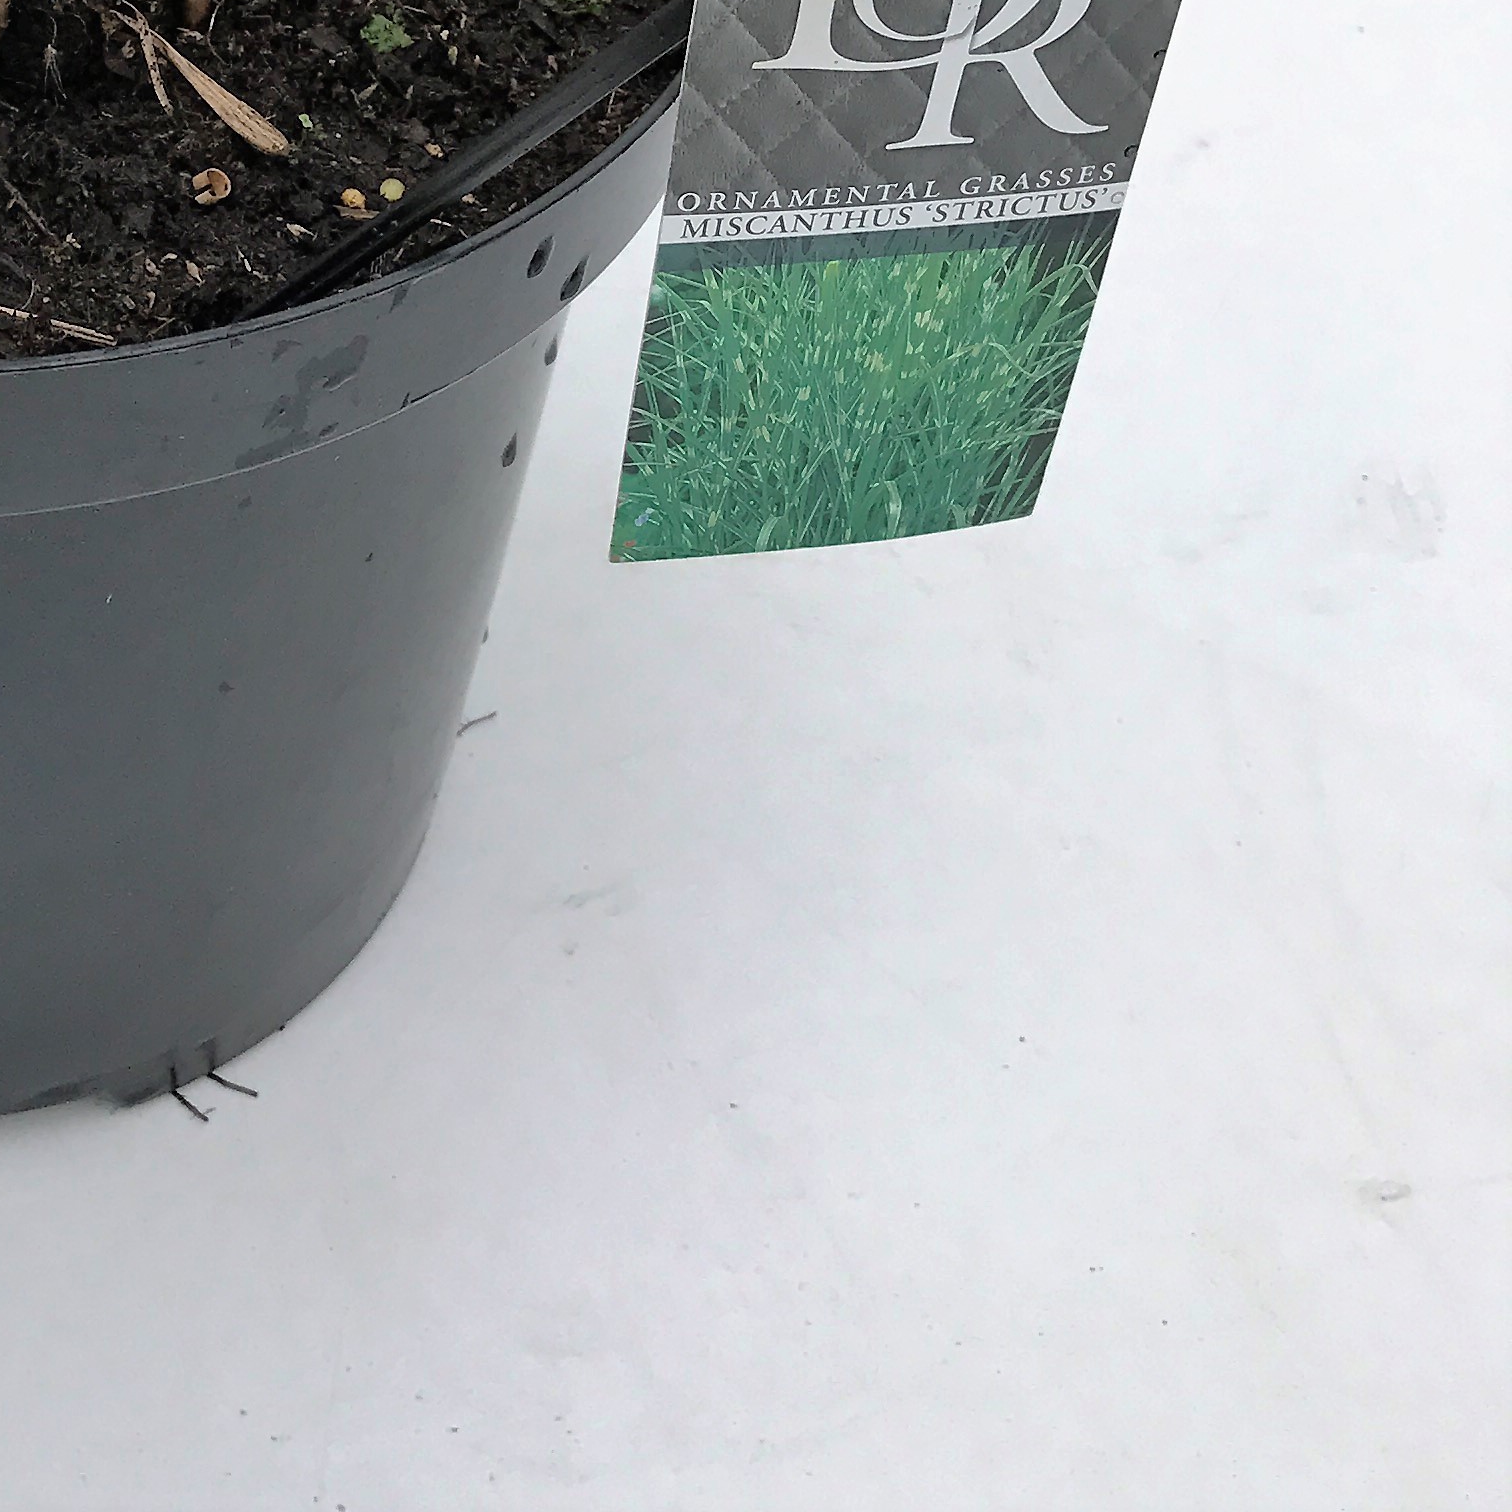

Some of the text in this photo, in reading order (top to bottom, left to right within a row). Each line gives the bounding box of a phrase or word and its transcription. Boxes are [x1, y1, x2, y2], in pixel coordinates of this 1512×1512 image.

[677, 161, 1117, 213] ORNAMENTAL GRASSES
[679, 205, 914, 239] MISCANTHUS
